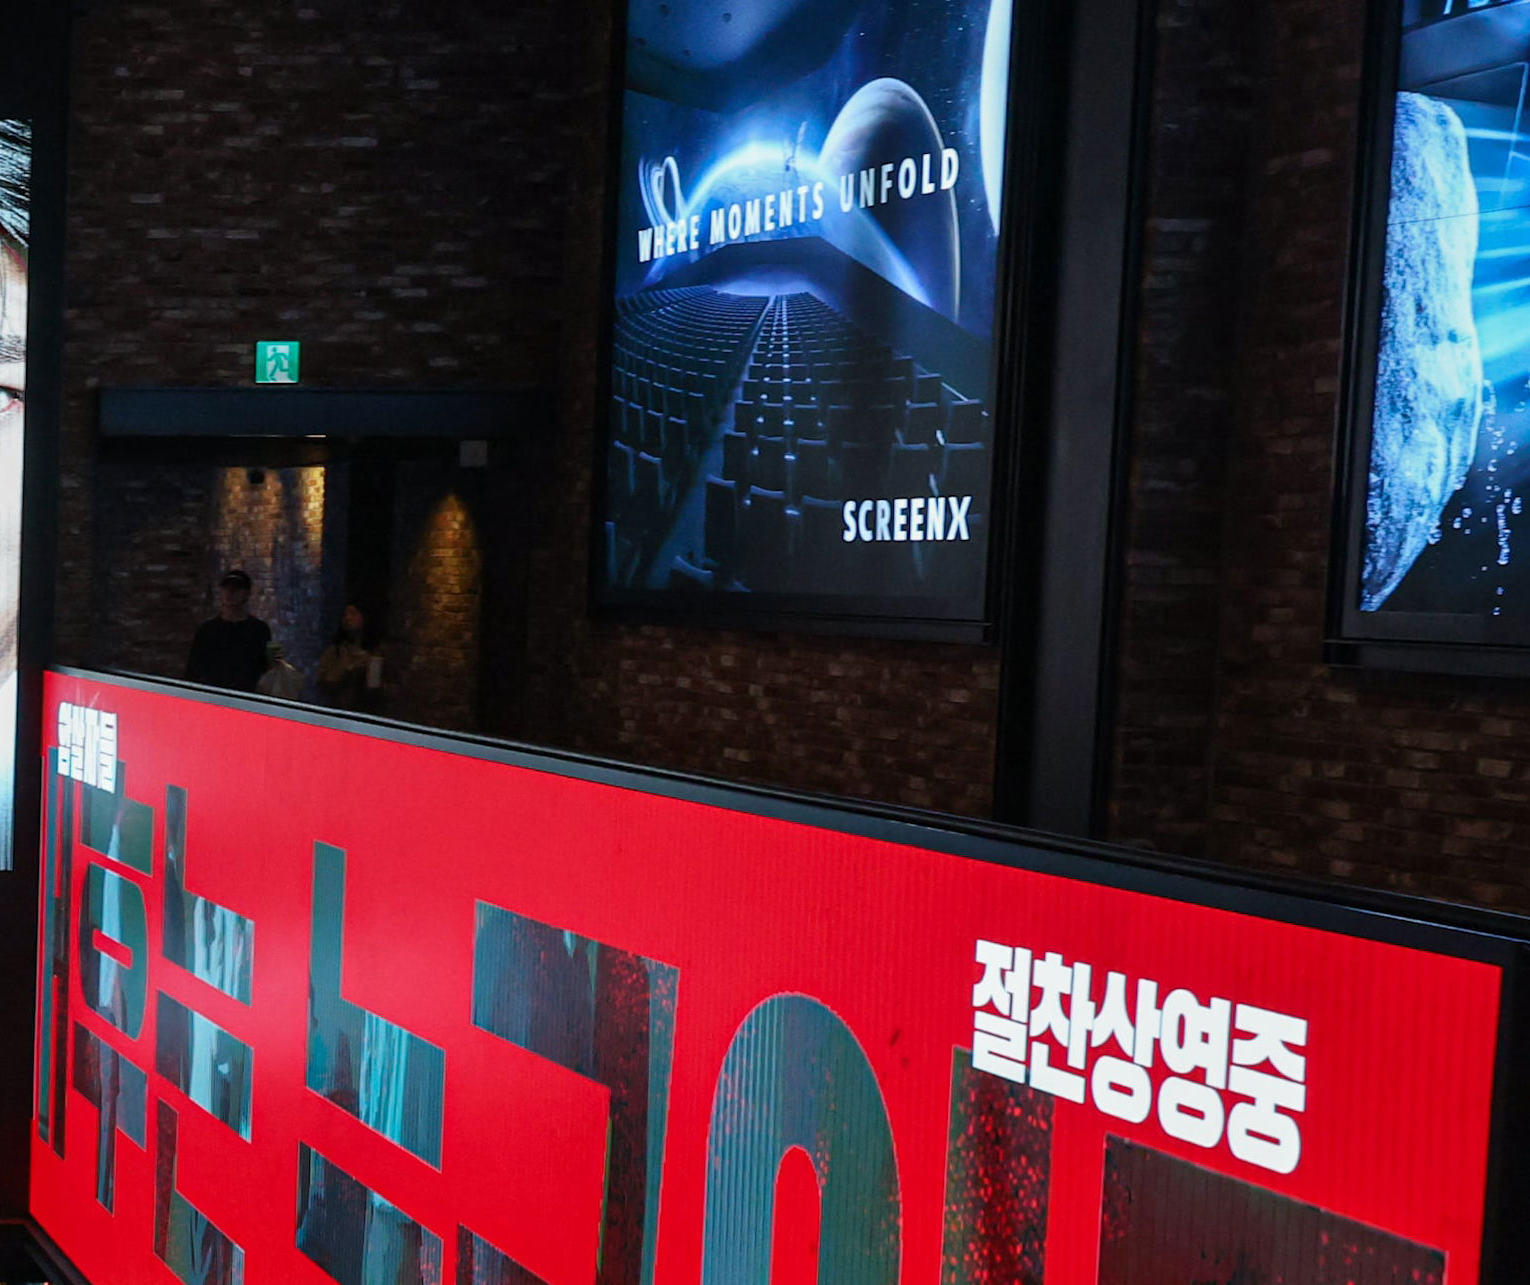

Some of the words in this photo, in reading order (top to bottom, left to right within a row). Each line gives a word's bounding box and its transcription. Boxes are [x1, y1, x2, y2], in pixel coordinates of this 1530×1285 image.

[638, 215, 700, 262] WHERE
[710, 182, 825, 245] MOMENTS
[840, 147, 960, 212] UNFOLD
[842, 495, 972, 542] SCREENX
[971, 938, 1310, 1177] 절찬상영중
